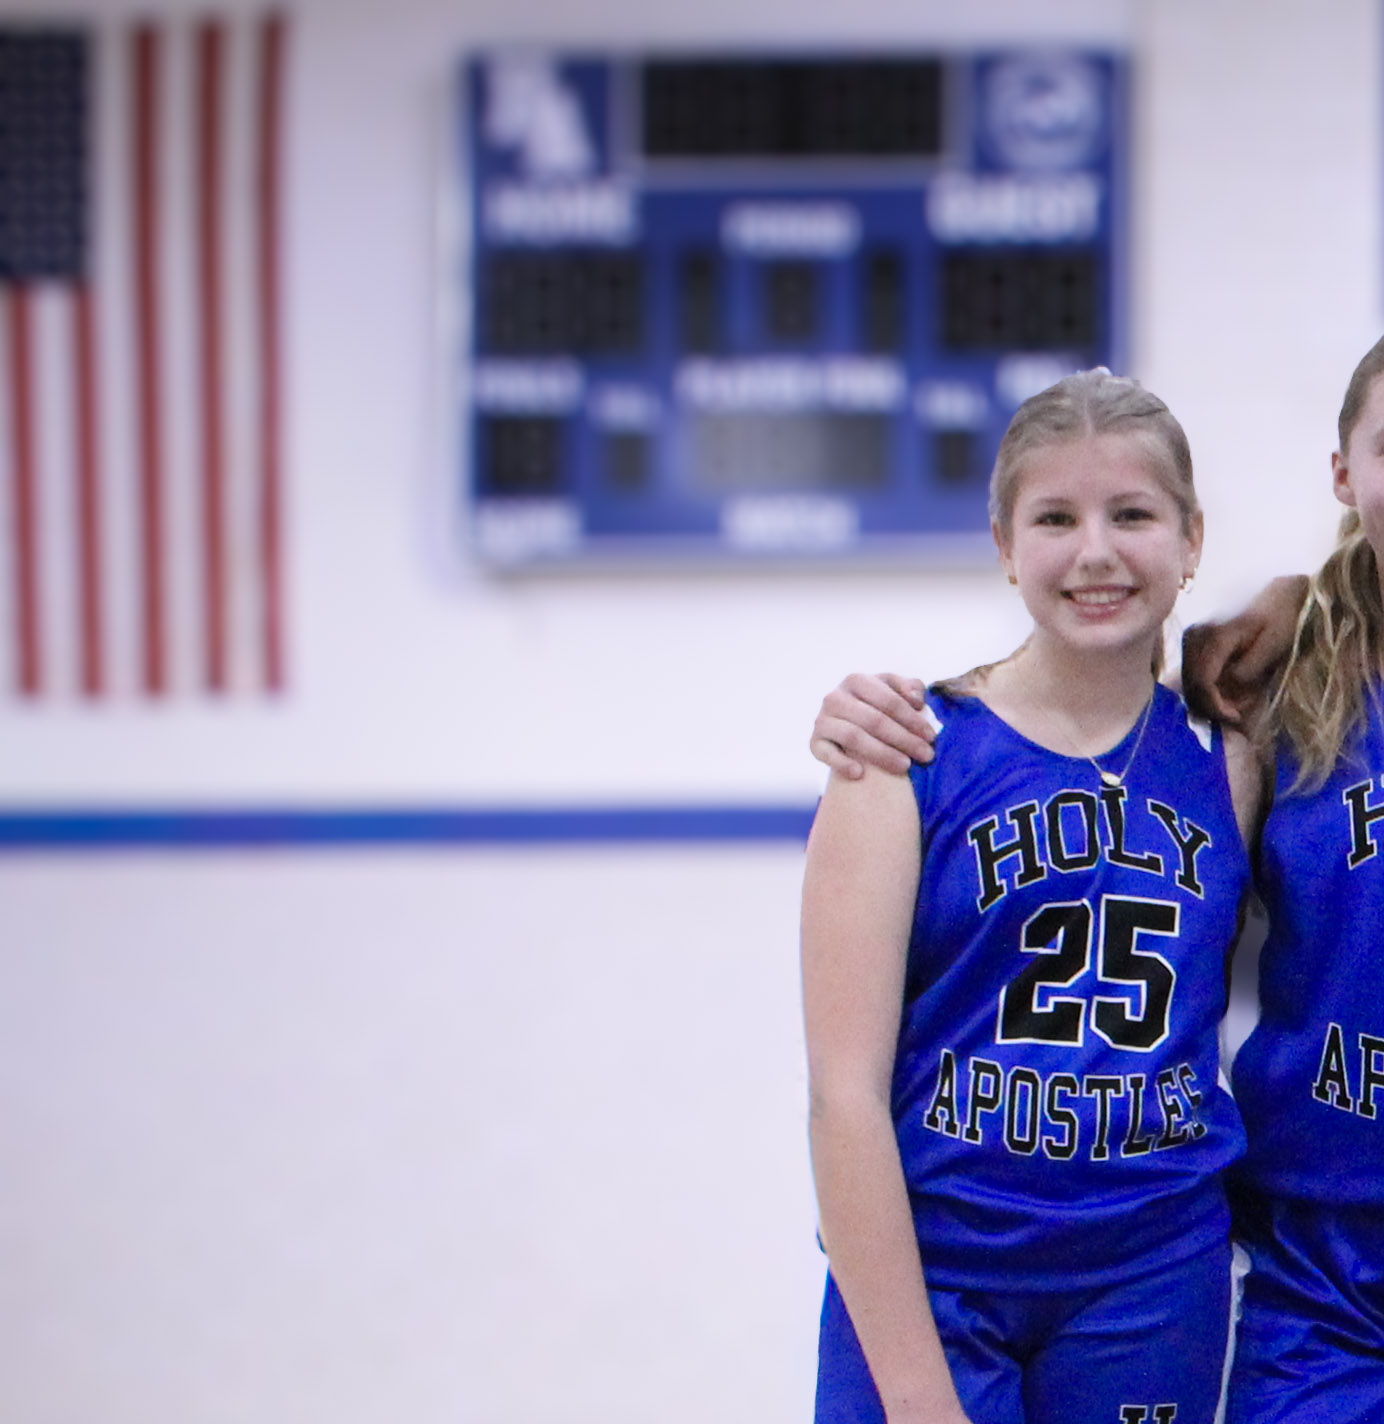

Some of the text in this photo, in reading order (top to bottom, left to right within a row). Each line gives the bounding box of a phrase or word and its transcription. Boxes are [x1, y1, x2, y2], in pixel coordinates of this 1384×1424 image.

[967, 785, 1212, 913] HOLY
[996, 893, 1181, 1053] 25
[923, 1048, 1208, 1162] APOSTLES
